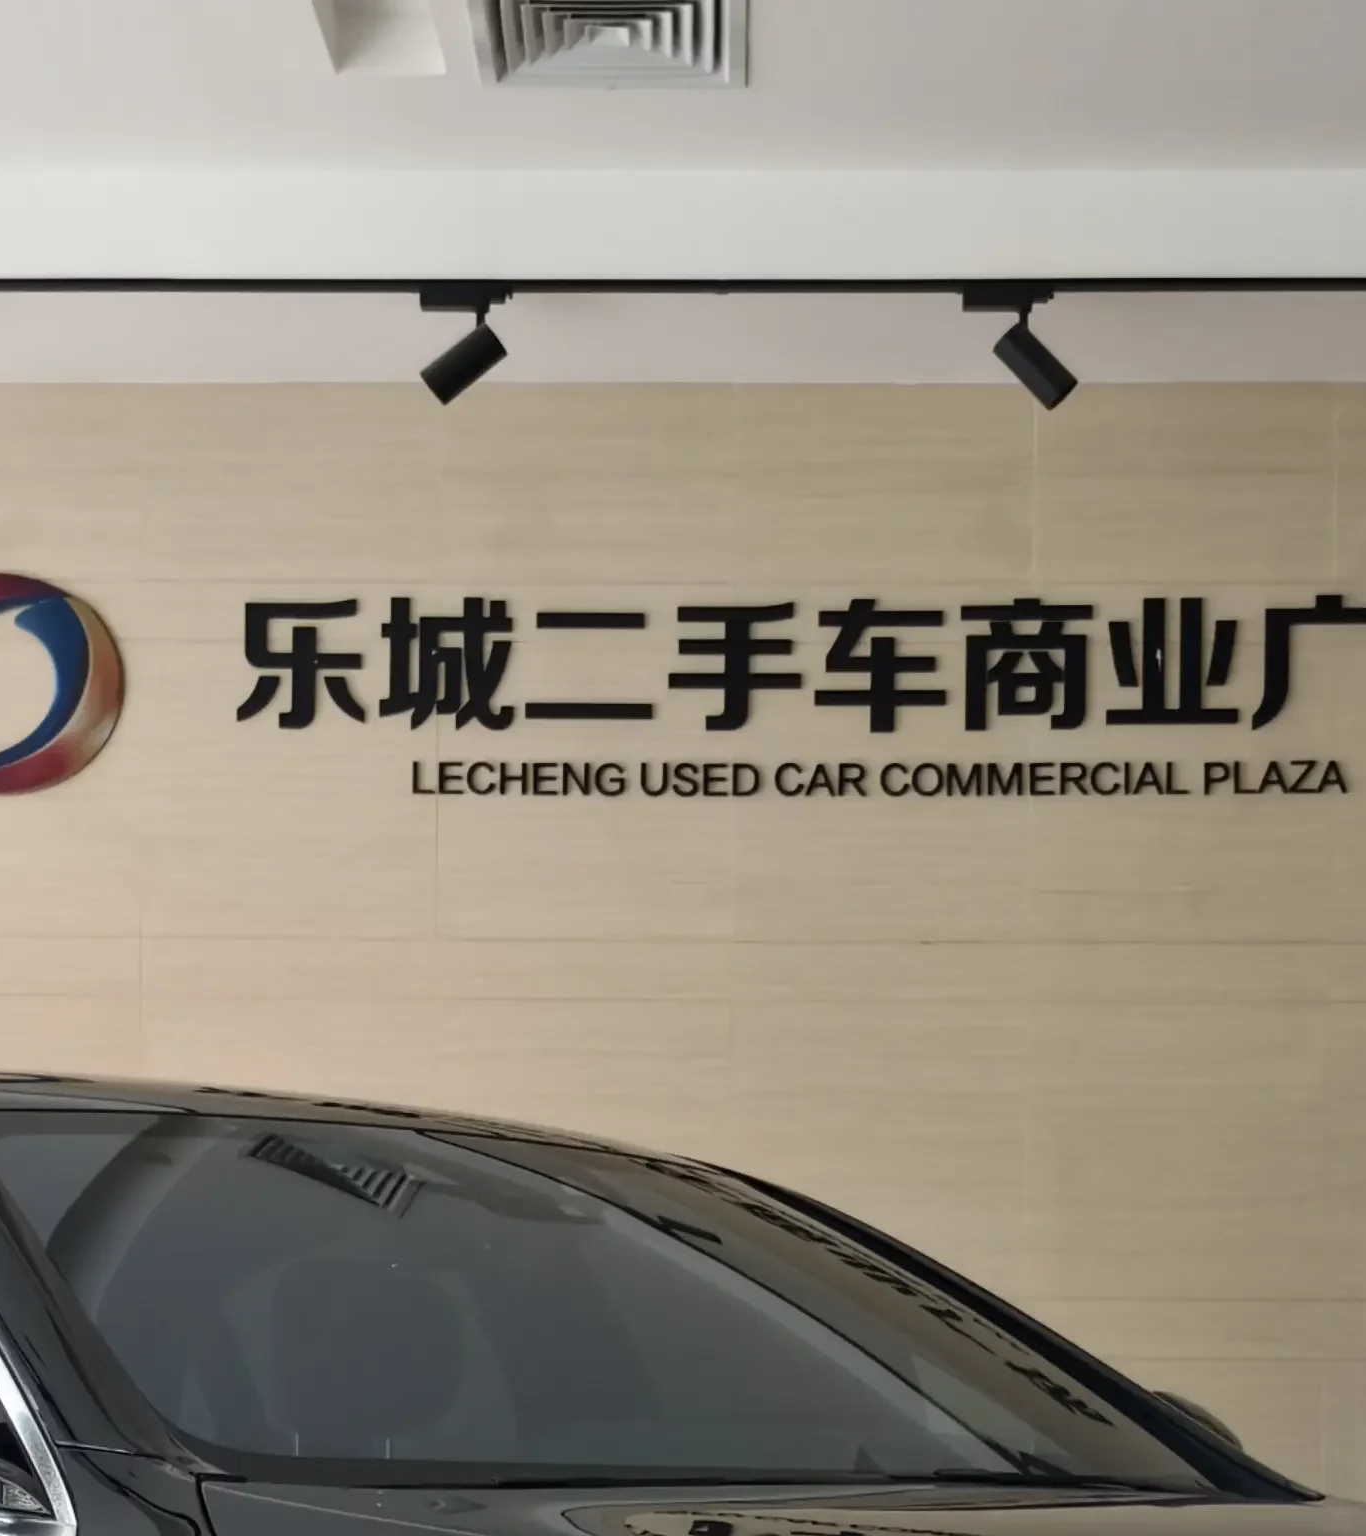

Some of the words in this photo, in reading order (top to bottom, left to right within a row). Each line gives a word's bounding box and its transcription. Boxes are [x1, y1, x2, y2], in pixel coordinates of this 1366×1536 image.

[412, 761, 626, 797] LECHENG
[640, 762, 761, 797] USED
[774, 762, 867, 797] CAR
[880, 761, 1190, 797] COMMERCIAL
[1203, 759, 1348, 796] PLAZA
